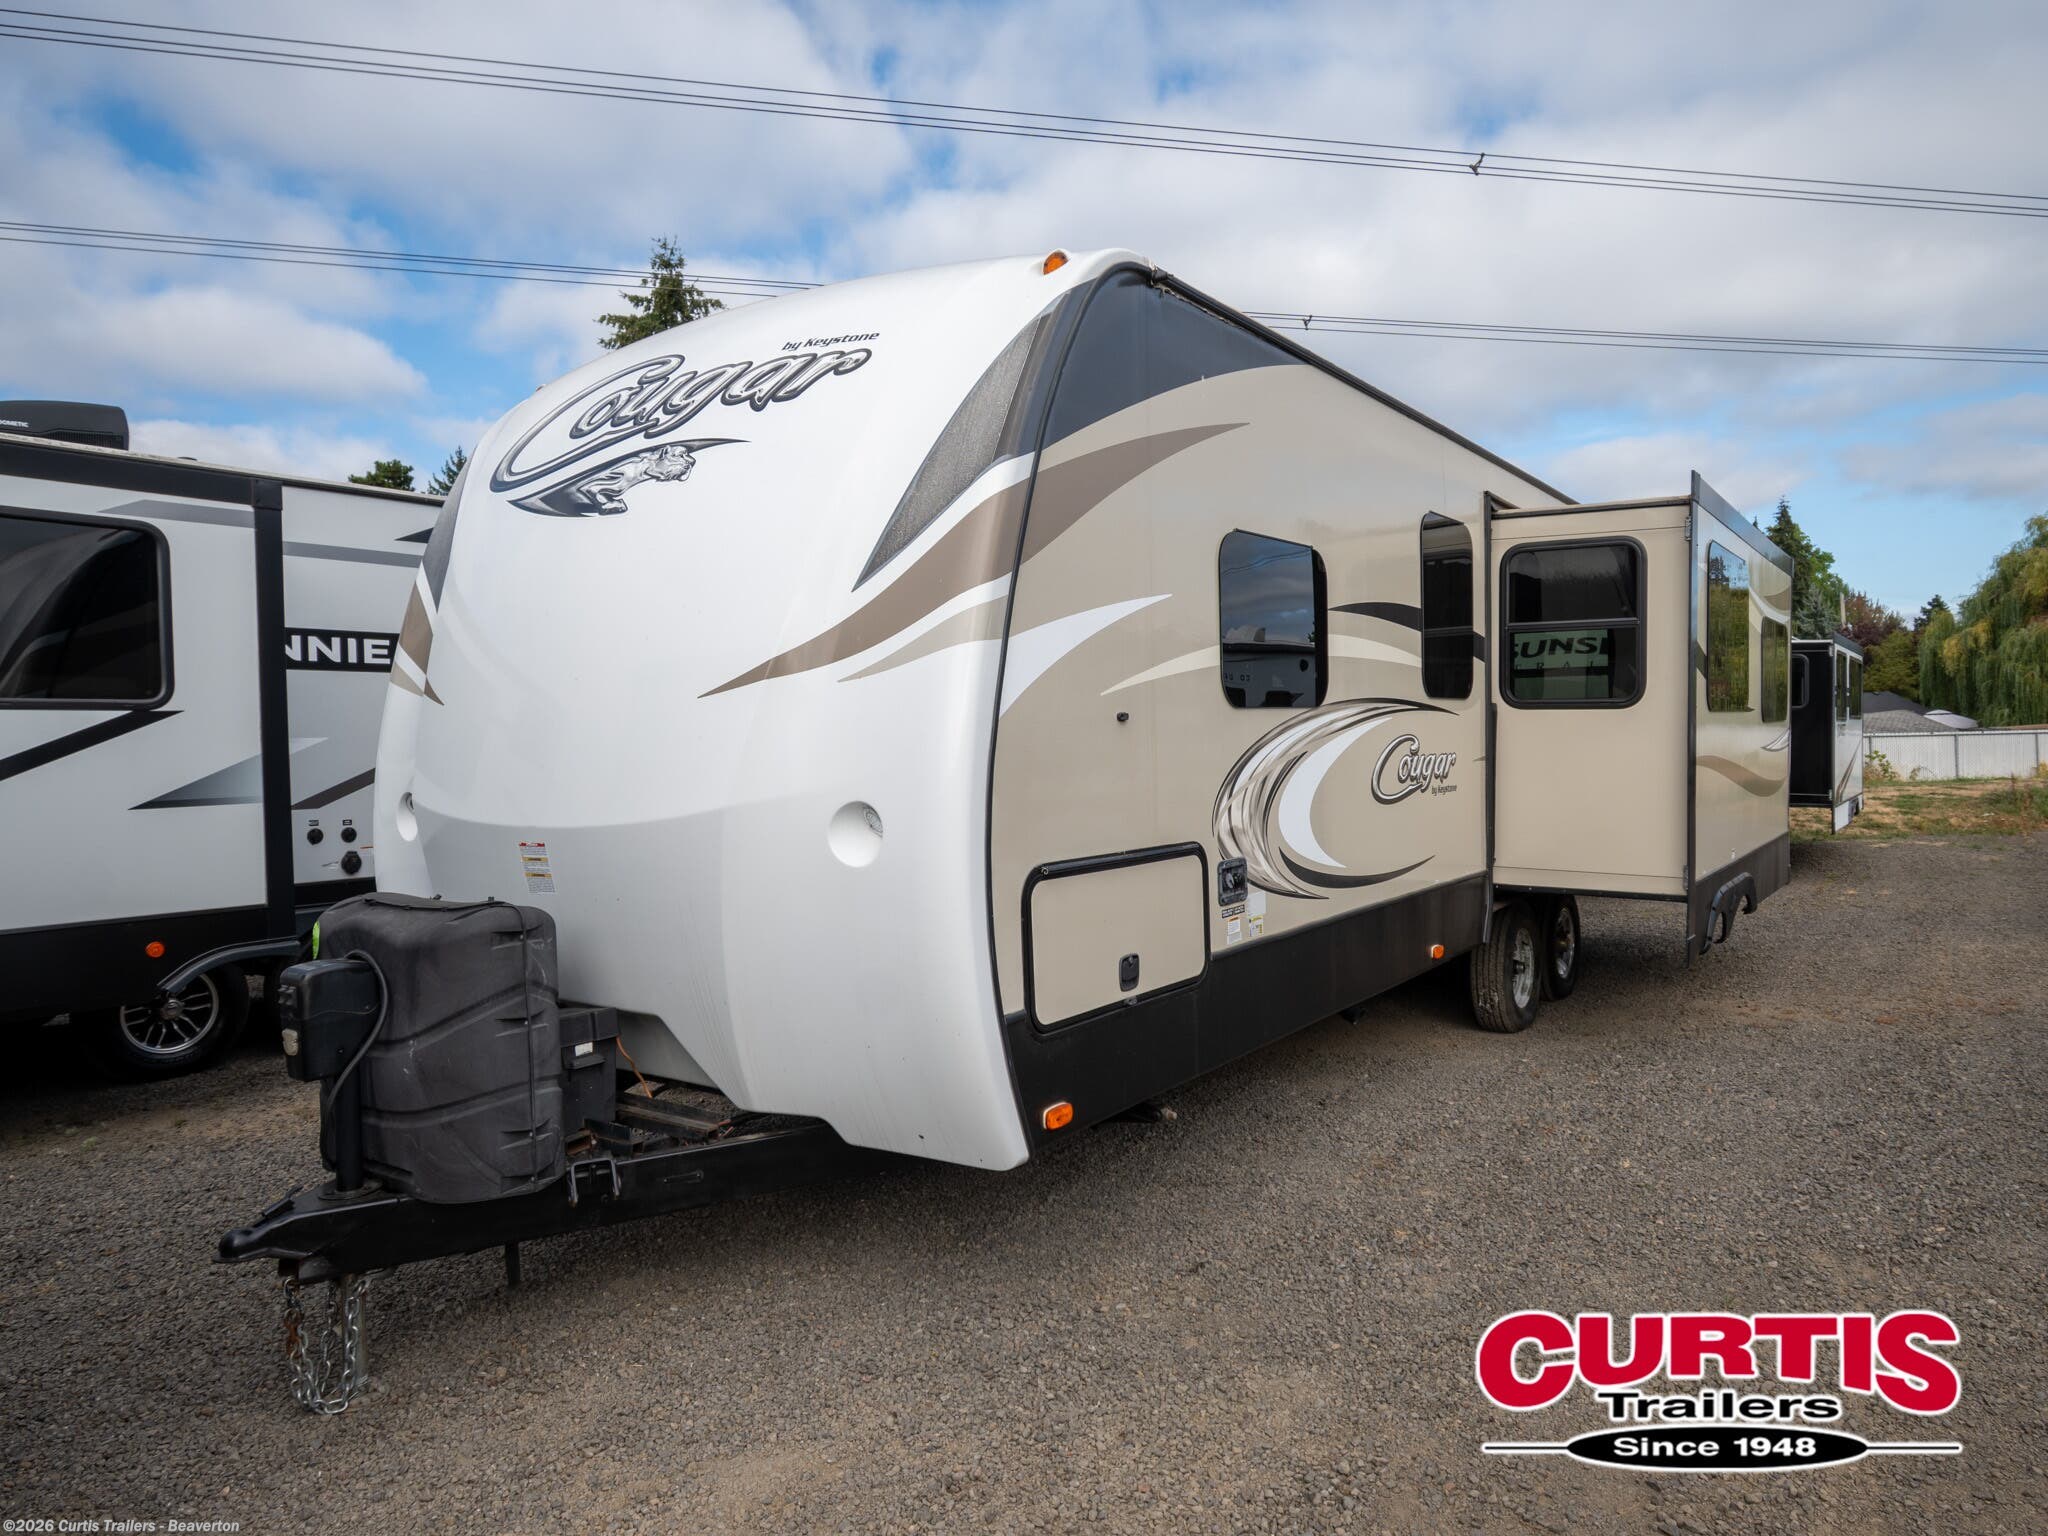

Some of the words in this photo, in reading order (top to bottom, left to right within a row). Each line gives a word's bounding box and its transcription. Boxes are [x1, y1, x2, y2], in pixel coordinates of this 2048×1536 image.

[782, 341, 803, 351] by
[804, 332, 880, 347] Keystone
[490, 347, 872, 493] Cougar
[1371, 734, 1457, 805] Cougar
